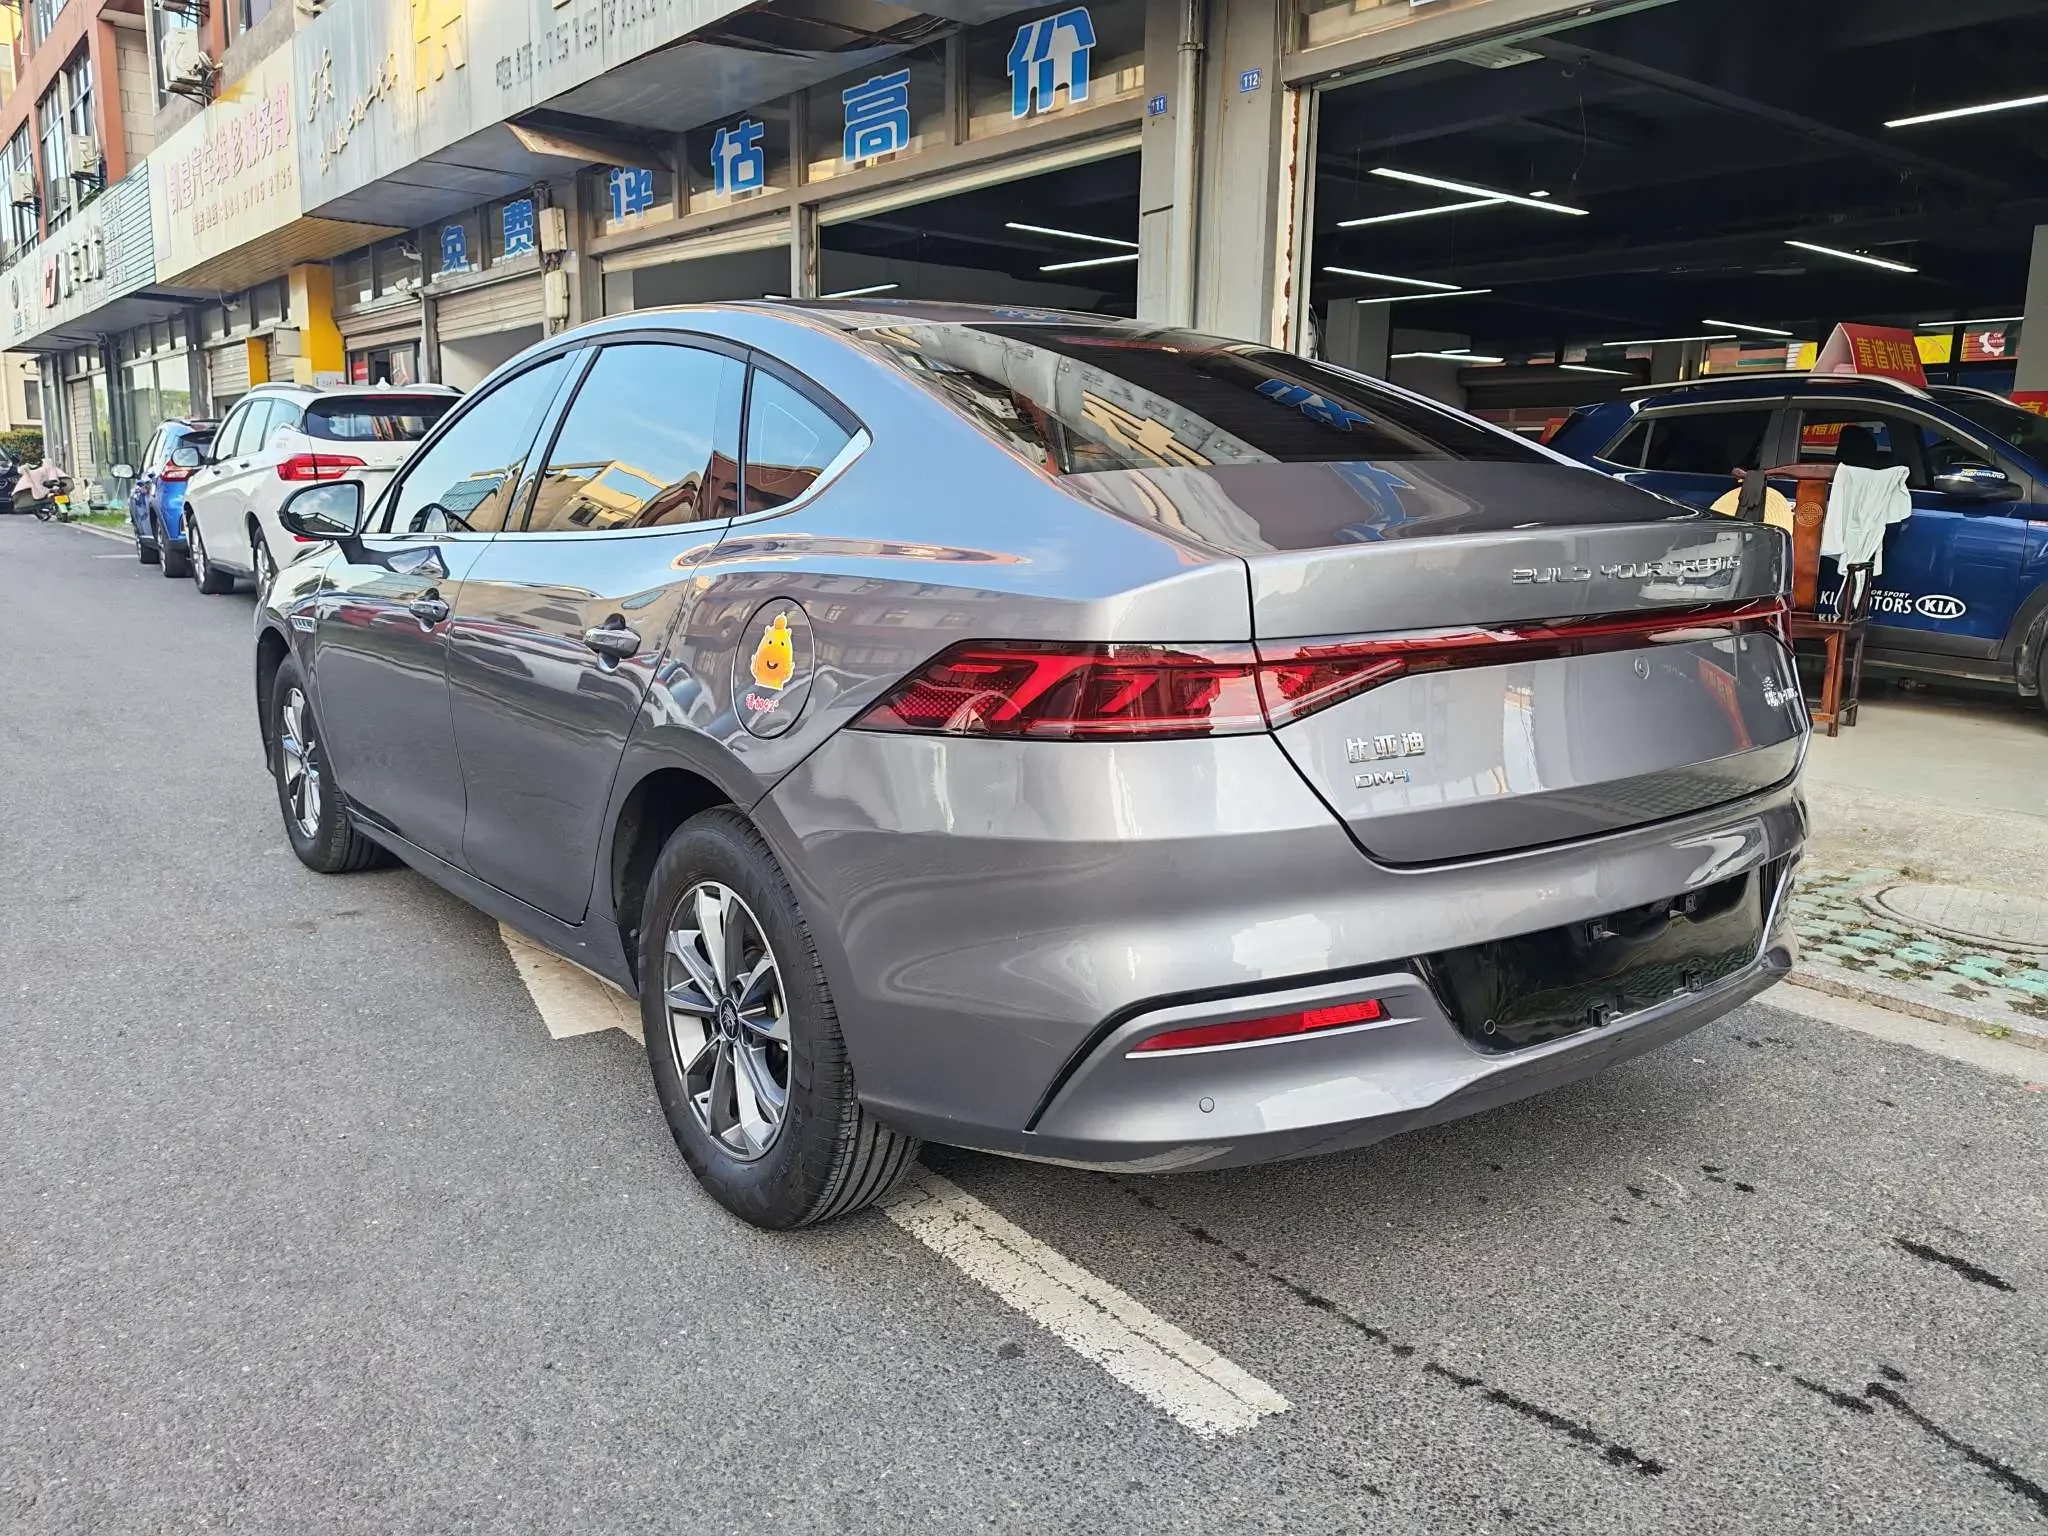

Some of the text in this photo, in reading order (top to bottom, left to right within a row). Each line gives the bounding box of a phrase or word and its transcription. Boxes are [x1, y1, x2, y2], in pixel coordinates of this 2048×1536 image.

[1243, 73, 1258, 88] 112
[1856, 336, 1918, 373] 靠谱划算
[1511, 565, 1593, 585] BUILD
[1599, 560, 1664, 580] YOUR
[1820, 590, 1913, 614] KI TORS
[1883, 591, 1910, 599] SPORT
[1924, 598, 1957, 615] KIA
[1346, 731, 1425, 763] 比亚迪
